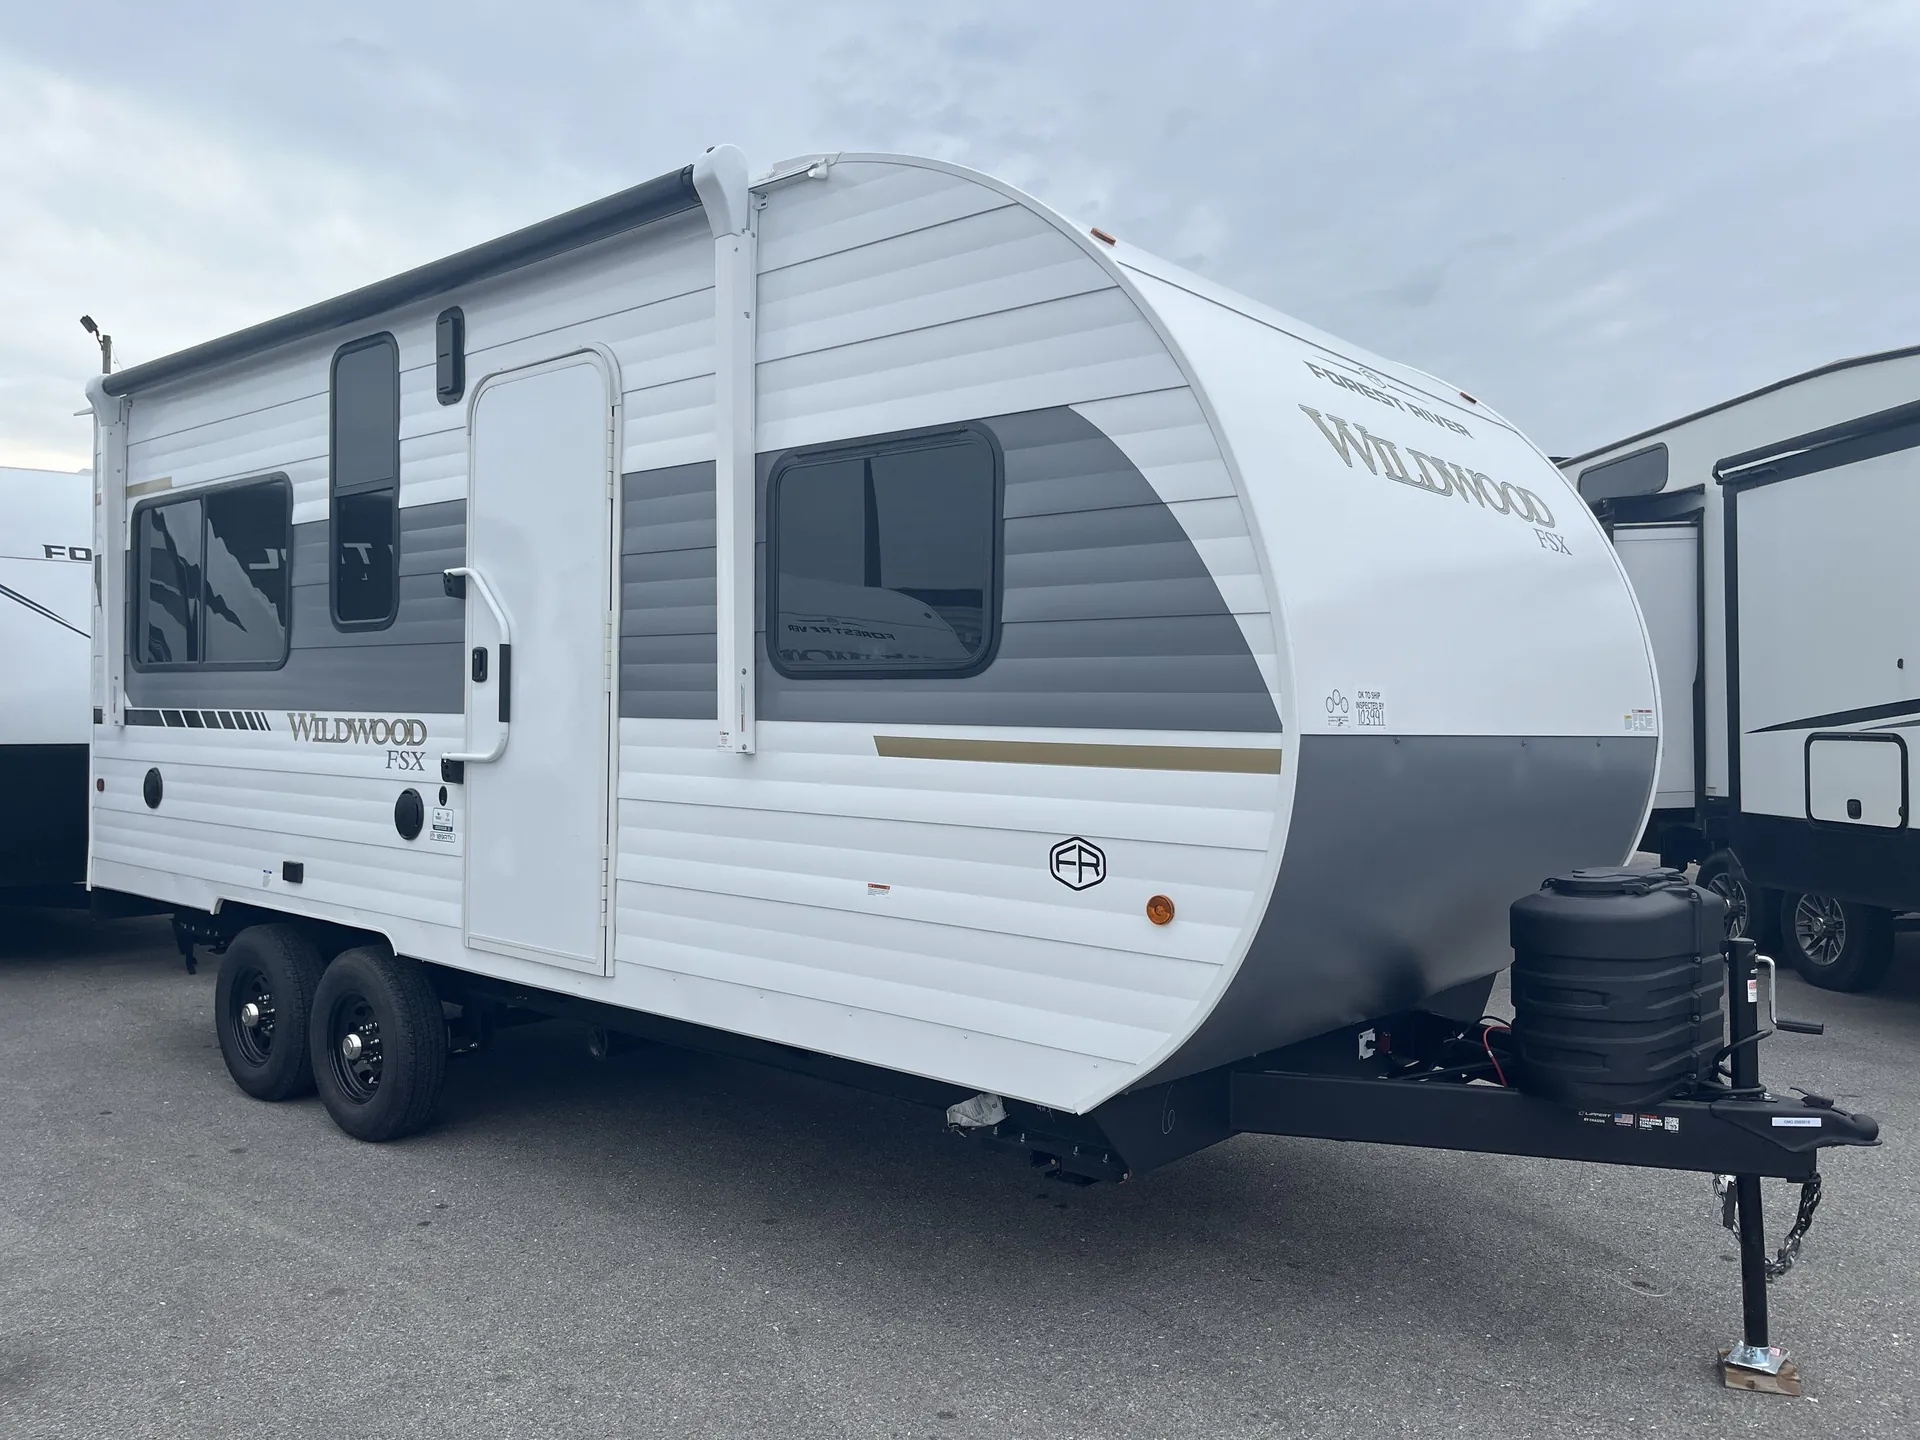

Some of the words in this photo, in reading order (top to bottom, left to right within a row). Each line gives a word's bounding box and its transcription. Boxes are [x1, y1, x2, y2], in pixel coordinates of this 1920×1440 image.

[1303, 360, 1406, 411] FOREST
[1407, 400, 1475, 440] RIVER
[1297, 403, 1556, 529] WILDWOOD
[1532, 528, 1573, 556] FSX
[1355, 701, 1379, 710] INSPECTED
[1379, 702, 1385, 710] BY
[1365, 691, 1371, 699] TO
[1371, 691, 1381, 700] SHIP
[287, 712, 427, 746] WILDWOOD
[385, 750, 427, 771] FSX
